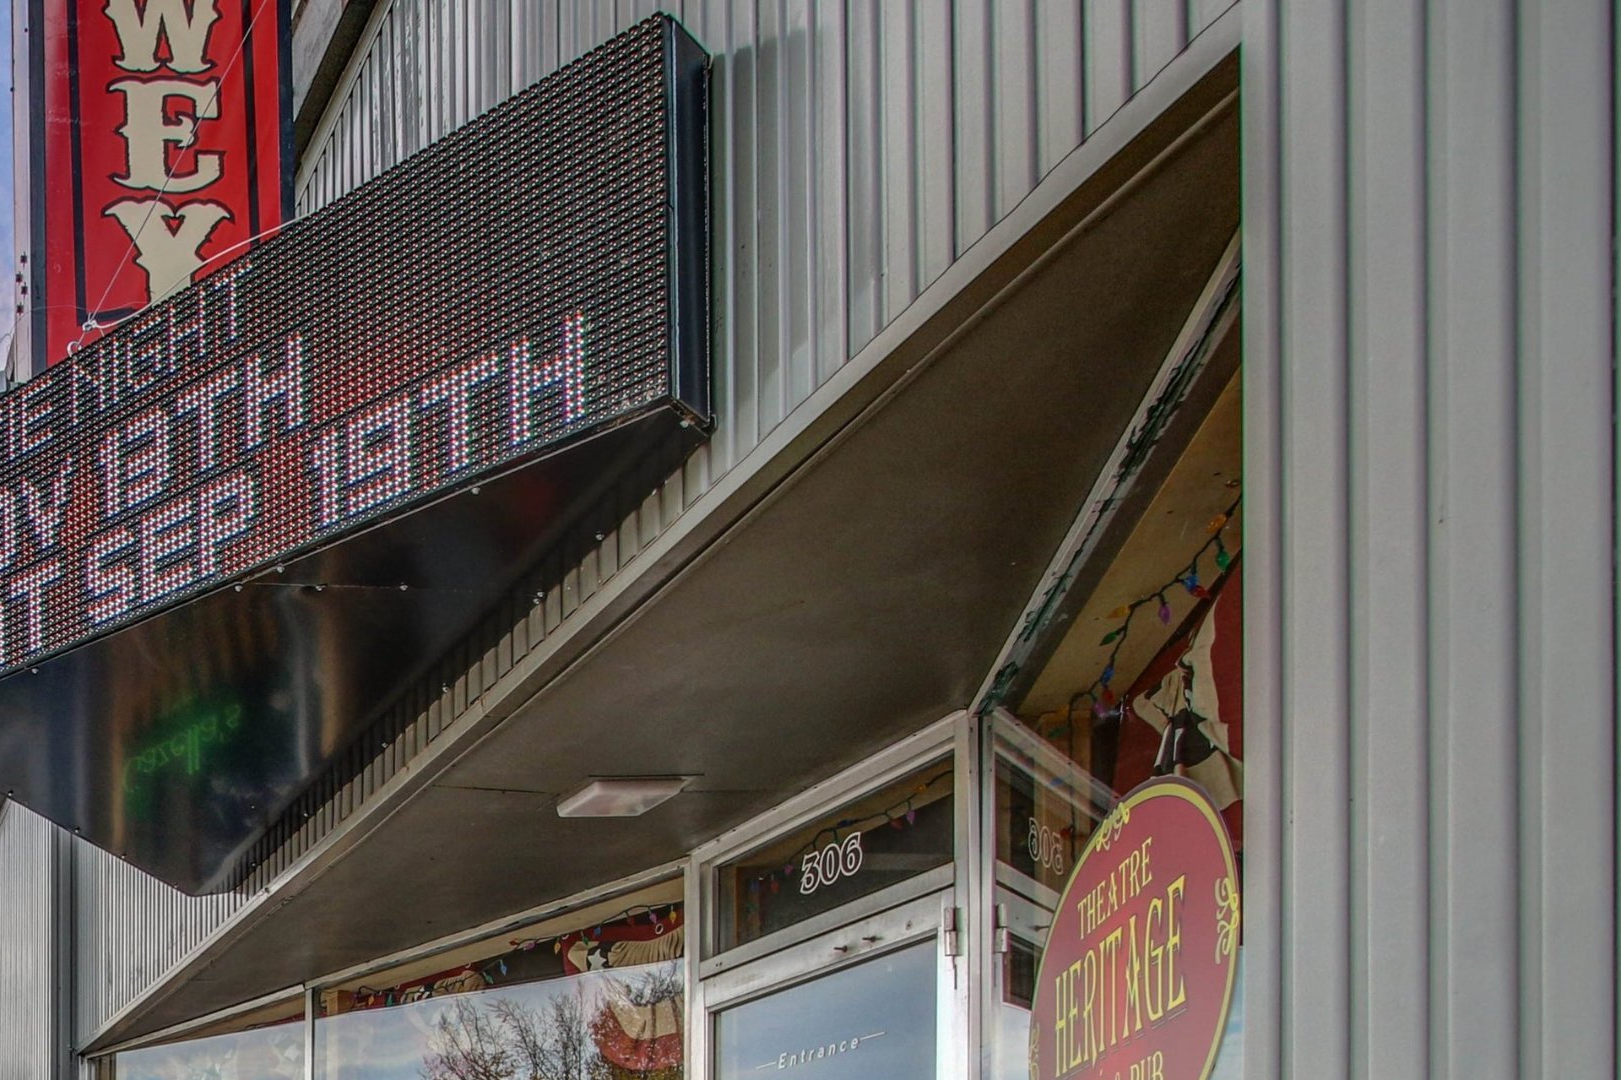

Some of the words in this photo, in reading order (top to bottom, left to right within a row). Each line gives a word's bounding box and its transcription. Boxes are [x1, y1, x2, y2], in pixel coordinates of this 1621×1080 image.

[71, 260, 253, 426] NIGHT
[86, 467, 255, 622] SEP
[312, 310, 587, 527] 19TH
[800, 831, 863, 894] 306
[1077, 836, 1154, 941] THEATRE
[1054, 874, 1188, 1079] HERITAGE
[778, 1036, 860, 1070] Entrance
